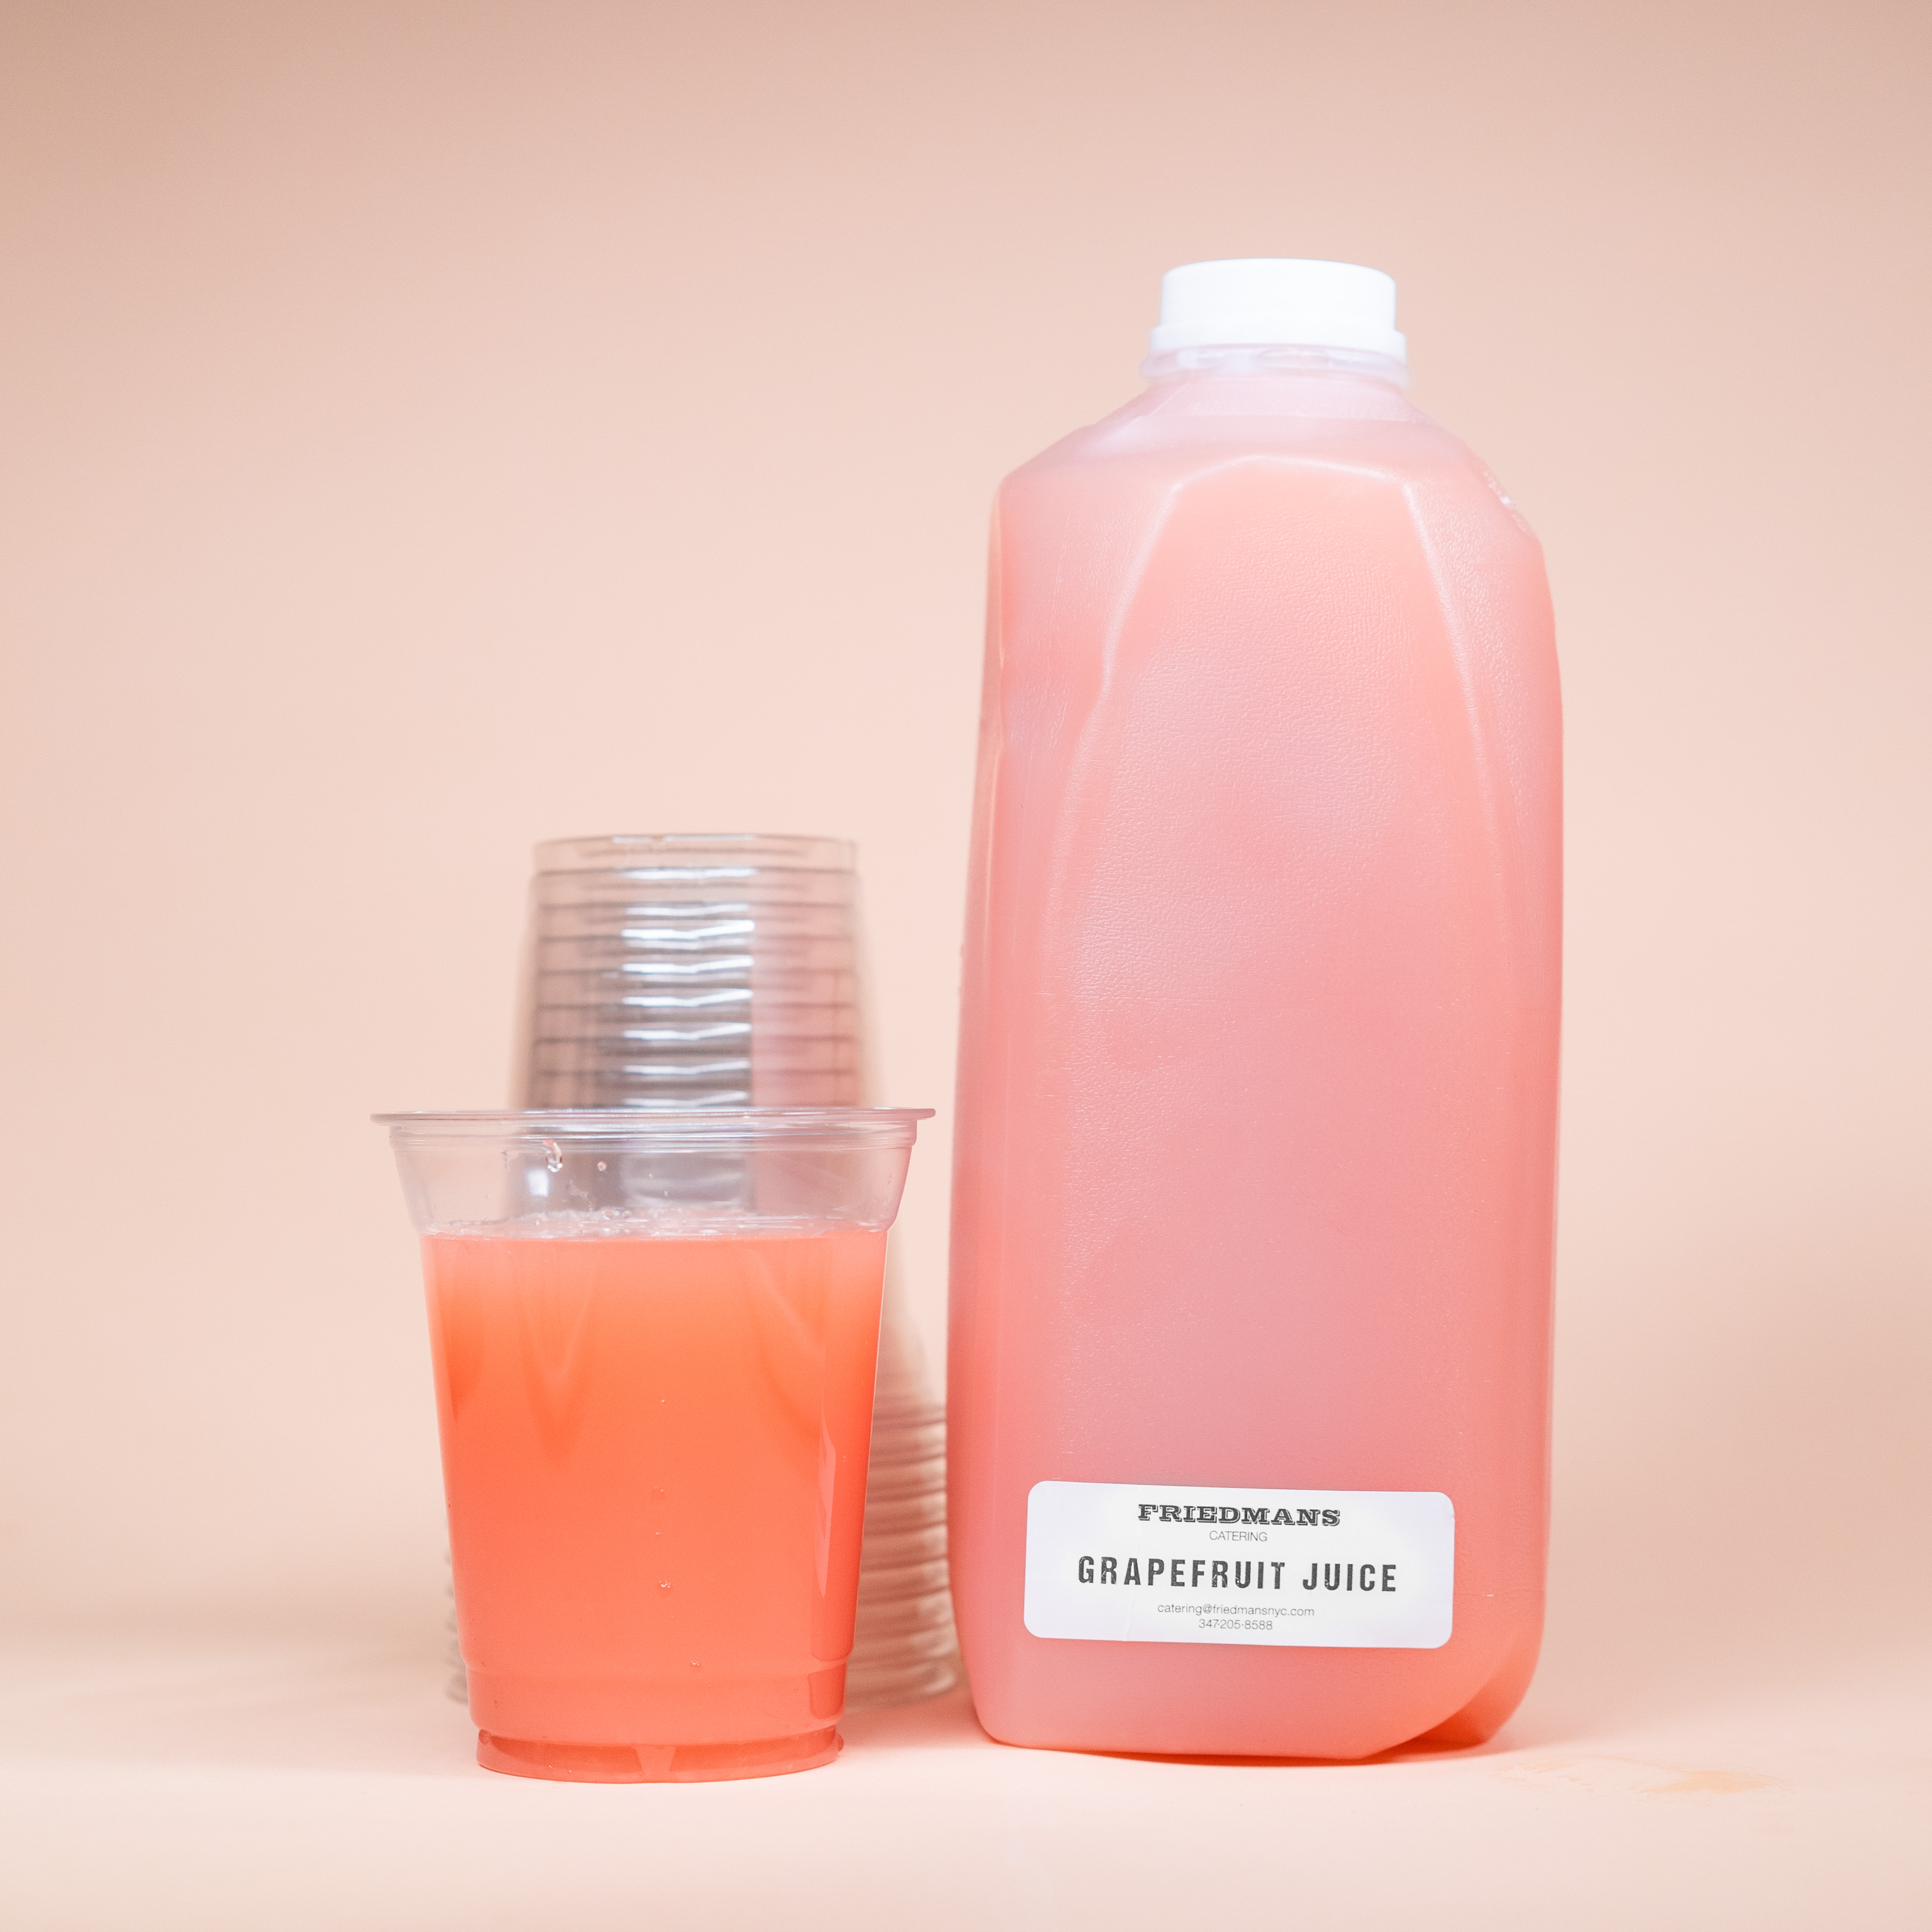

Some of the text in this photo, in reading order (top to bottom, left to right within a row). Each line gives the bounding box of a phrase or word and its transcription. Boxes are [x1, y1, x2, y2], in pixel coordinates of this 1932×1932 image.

[1138, 1504, 1341, 1527] FRIEDMANS
[1209, 1530, 1268, 1542] CATERING
[1078, 1555, 1397, 1592] GRAPEFRUIT JUICE
[1157, 1603, 1314, 1617] catering@friedmansnyc.com
